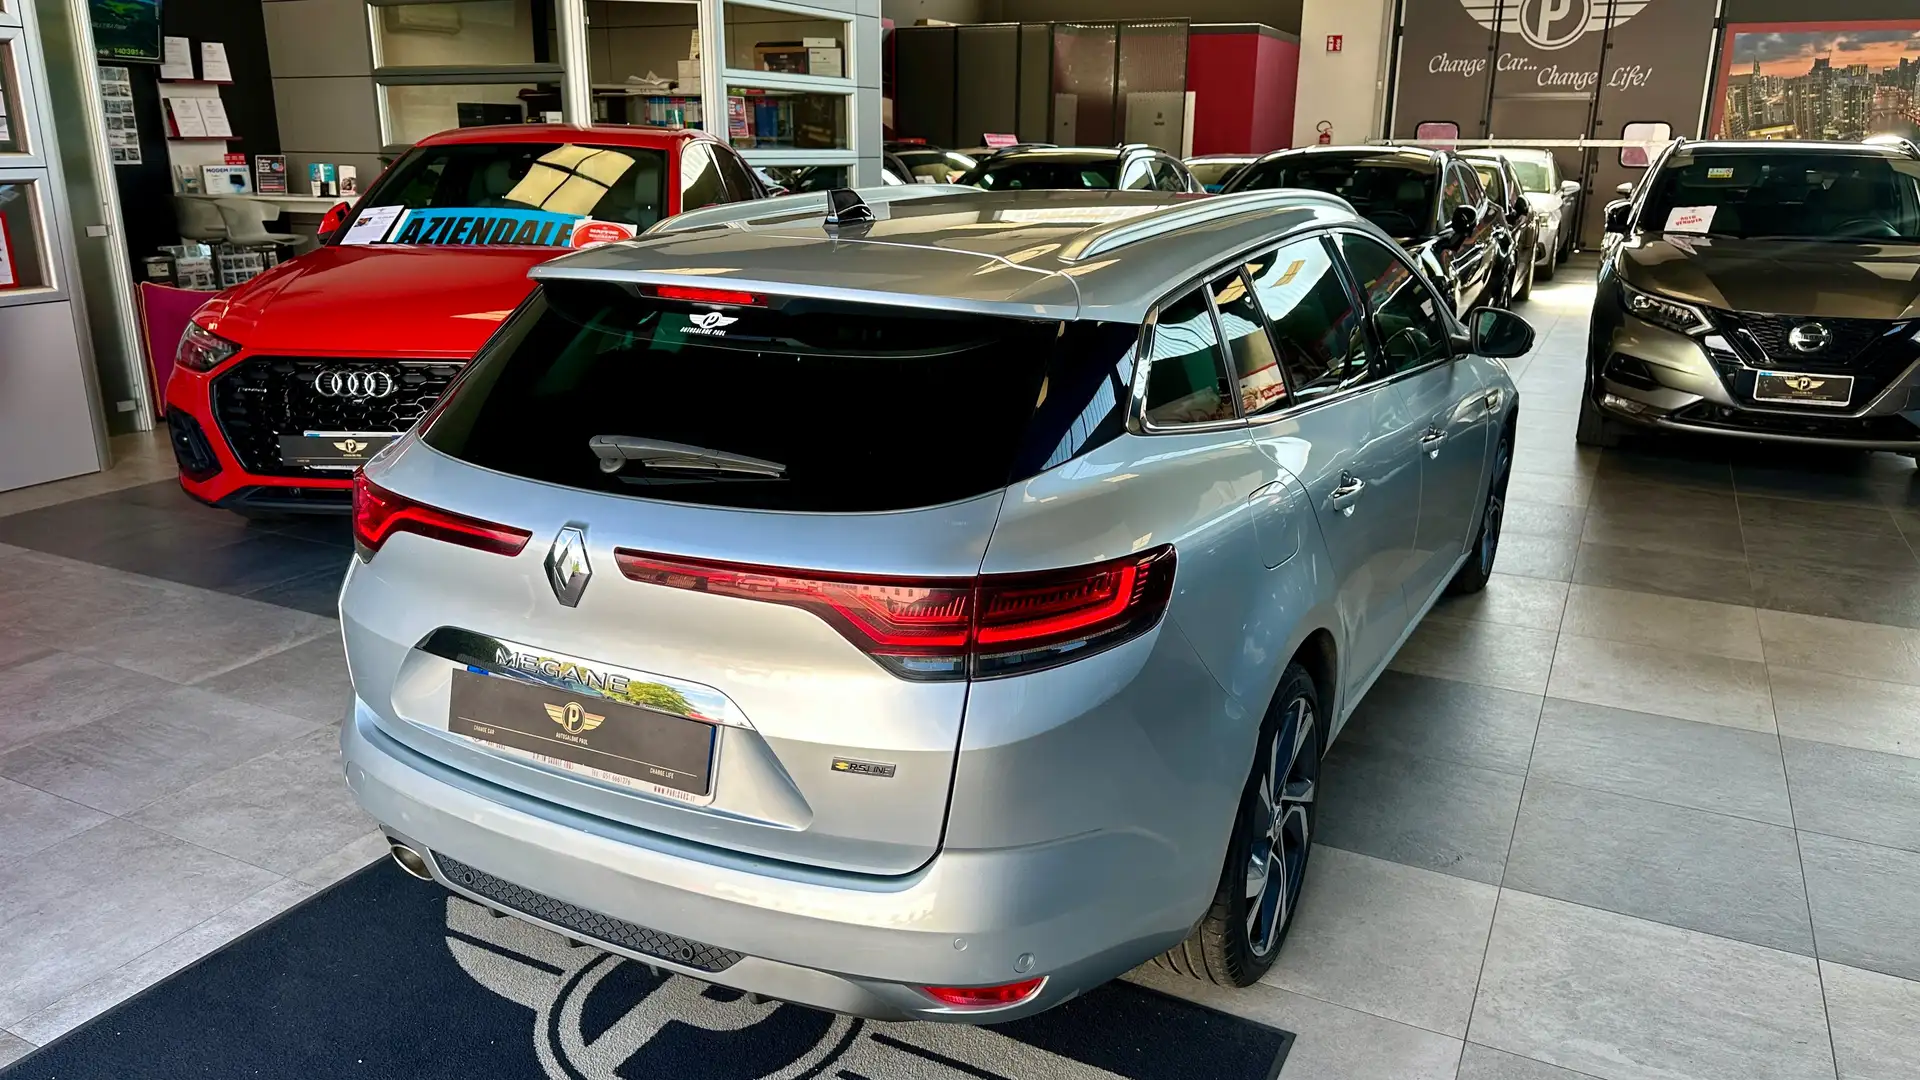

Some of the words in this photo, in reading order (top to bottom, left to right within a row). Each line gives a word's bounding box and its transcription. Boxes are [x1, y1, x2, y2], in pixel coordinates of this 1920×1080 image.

[1428, 52, 1486, 77] Change
[1497, 53, 1538, 71] Car...
[1537, 65, 1598, 90] Change
[1607, 64, 1652, 91] Life!
[495, 647, 631, 695] MEGANE
